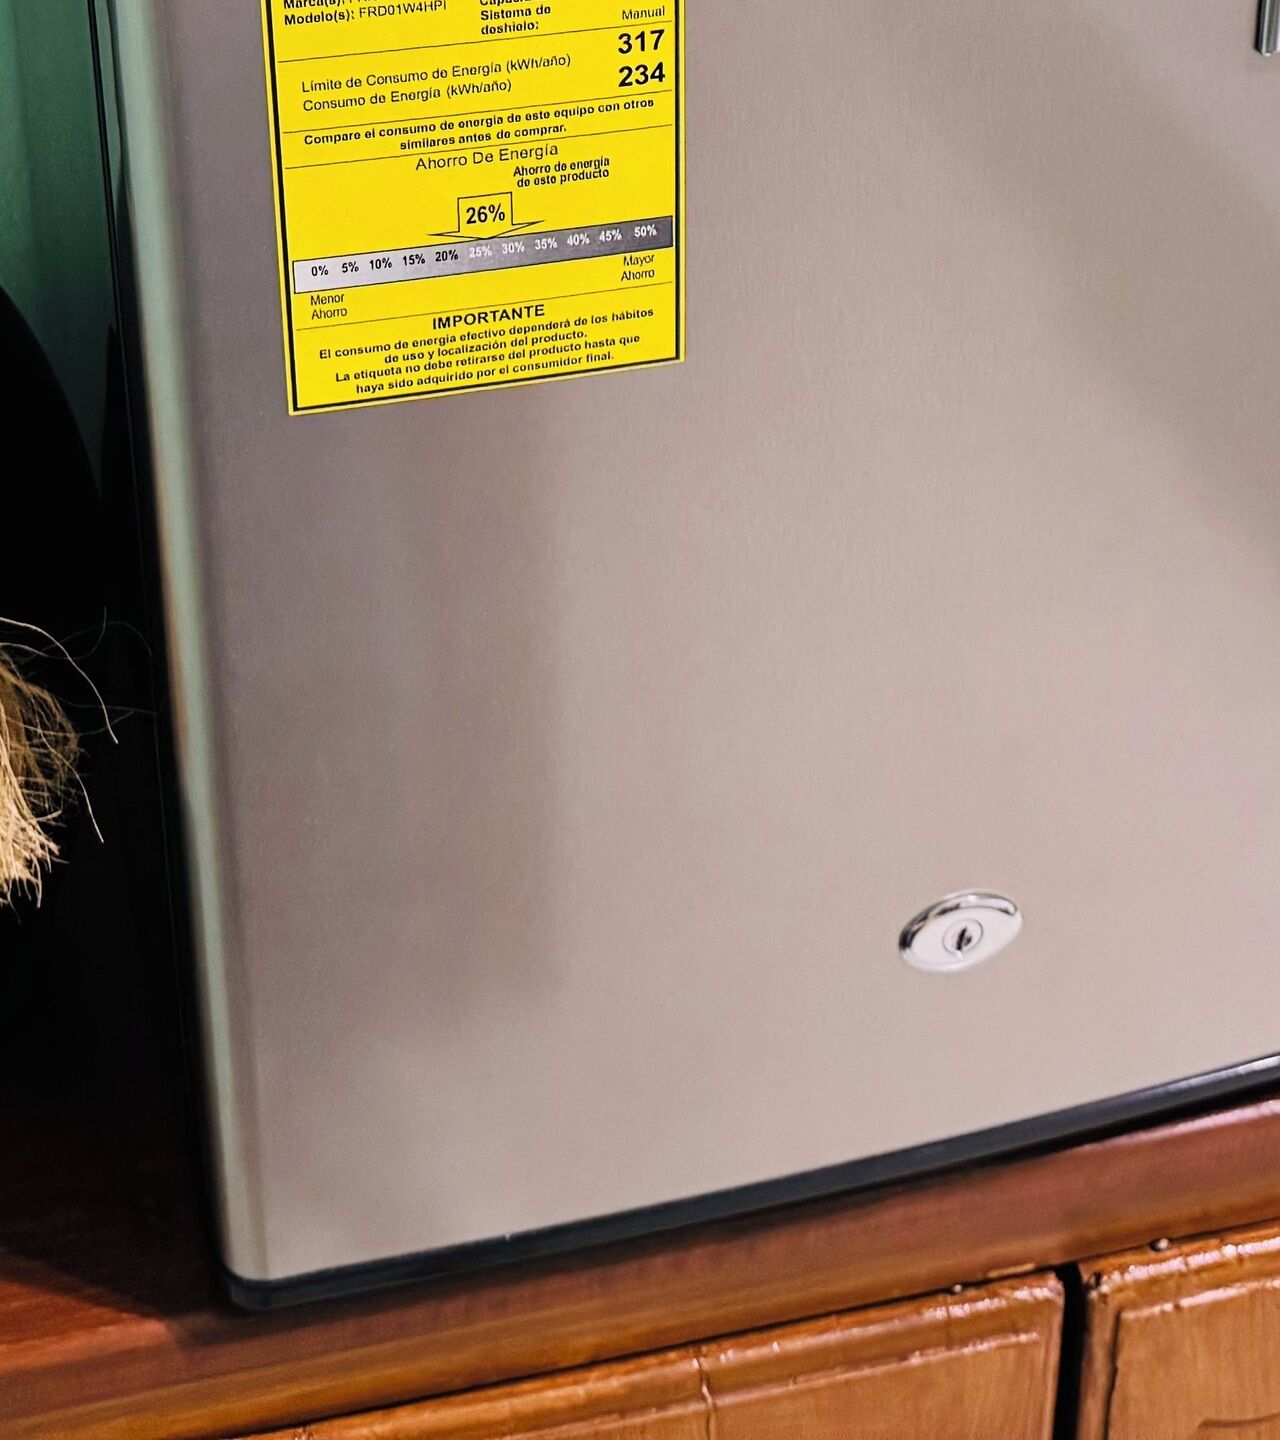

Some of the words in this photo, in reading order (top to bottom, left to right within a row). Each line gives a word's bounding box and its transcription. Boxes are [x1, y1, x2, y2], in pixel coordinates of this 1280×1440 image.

[285, 9, 355, 25] Modelo(s):
[481, 8, 531, 21] Sistema
[536, 5, 551, 15] de
[622, 5, 665, 20] Manual
[481, 21, 539, 35] deshielo:
[618, 29, 665, 54] 317
[302, 79, 341, 93] Límite
[346, 77, 362, 88] de
[367, 70, 427, 86] Consumo
[432, 68, 447, 79] de
[452, 62, 501, 77] Energía
[506, 54, 571, 74] (kWh/año)
[618, 62, 665, 87] 234
[303, 96, 365, 111] Consumo
[370, 93, 386, 104] de
[391, 87, 441, 102] Energía
[447, 79, 512, 99] (kWh/año)
[304, 131, 360, 145] Compare
[365, 128, 375, 139] el
[379, 123, 436, 137] consumo
[440, 120, 454, 130] de
[507, 113, 521, 123] de
[526, 111, 550, 121] este
[554, 105, 594, 119] equipo
[598, 102, 619, 112] con
[624, 98, 654, 109] otros
[400, 134, 455, 150] similares
[459, 130, 491, 143] antes
[497, 129, 510, 139] de
[515, 124, 567, 137] comprar.
[416, 155, 467, 170] Ahorro
[473, 151, 493, 164] De
[500, 144, 558, 160] Energía
[514, 164, 550, 177] Ahorro
[555, 161, 566, 171] de
[517, 177, 530, 187] de
[534, 174, 556, 185] este
[560, 167, 609, 184] producto
[466, 203, 505, 224] 26%
[311, 265, 328, 276] 0%
[342, 261, 359, 273] 5%
[370, 257, 392, 270] 10%
[403, 253, 425, 266] 15%
[435, 249, 458, 262] 20%
[469, 245, 493, 257] 25%
[502, 242, 525, 254] 30%
[535, 237, 558, 249] 35%
[567, 233, 590, 246] 40%
[599, 229, 622, 242] 45%
[634, 224, 657, 237] 50%
[623, 254, 655, 268] Mayor
[621, 269, 655, 282] Ahorro
[310, 293, 344, 306] Menor
[312, 307, 348, 319] Ahorro
[433, 304, 545, 330] IMPORTANTE
[320, 349, 330, 359] El
[335, 344, 391, 357] consumo
[394, 340, 408, 350] de
[460, 327, 505, 342] efectivo
[509, 318, 570, 336] dependerá
[574, 316, 588, 326] de
[592, 314, 608, 324] los
[612, 308, 653, 321] hábitos
[336, 372, 350, 382] La
[354, 365, 402, 381] etiqueta
[406, 364, 420, 372] no
[424, 358, 452, 370] debe
[456, 353, 504, 366] retirarse
[508, 349, 525, 359] del
[530, 342, 581, 359] producto
[585, 337, 615, 349] hasta
[620, 335, 640, 347] que
[385, 353, 398, 364] de
[403, 350, 424, 360] uso
[428, 350, 434, 360] y
[438, 338, 507, 357] localización
[511, 337, 528, 346] del
[532, 329, 587, 346] producto.
[356, 380, 384, 394] haya
[388, 375, 413, 389] sido
[417, 368, 473, 385] adquirido
[477, 366, 495, 379] por
[499, 363, 509, 374] el
[513, 356, 582, 372] consumidor
[586, 351, 613, 363] final.
